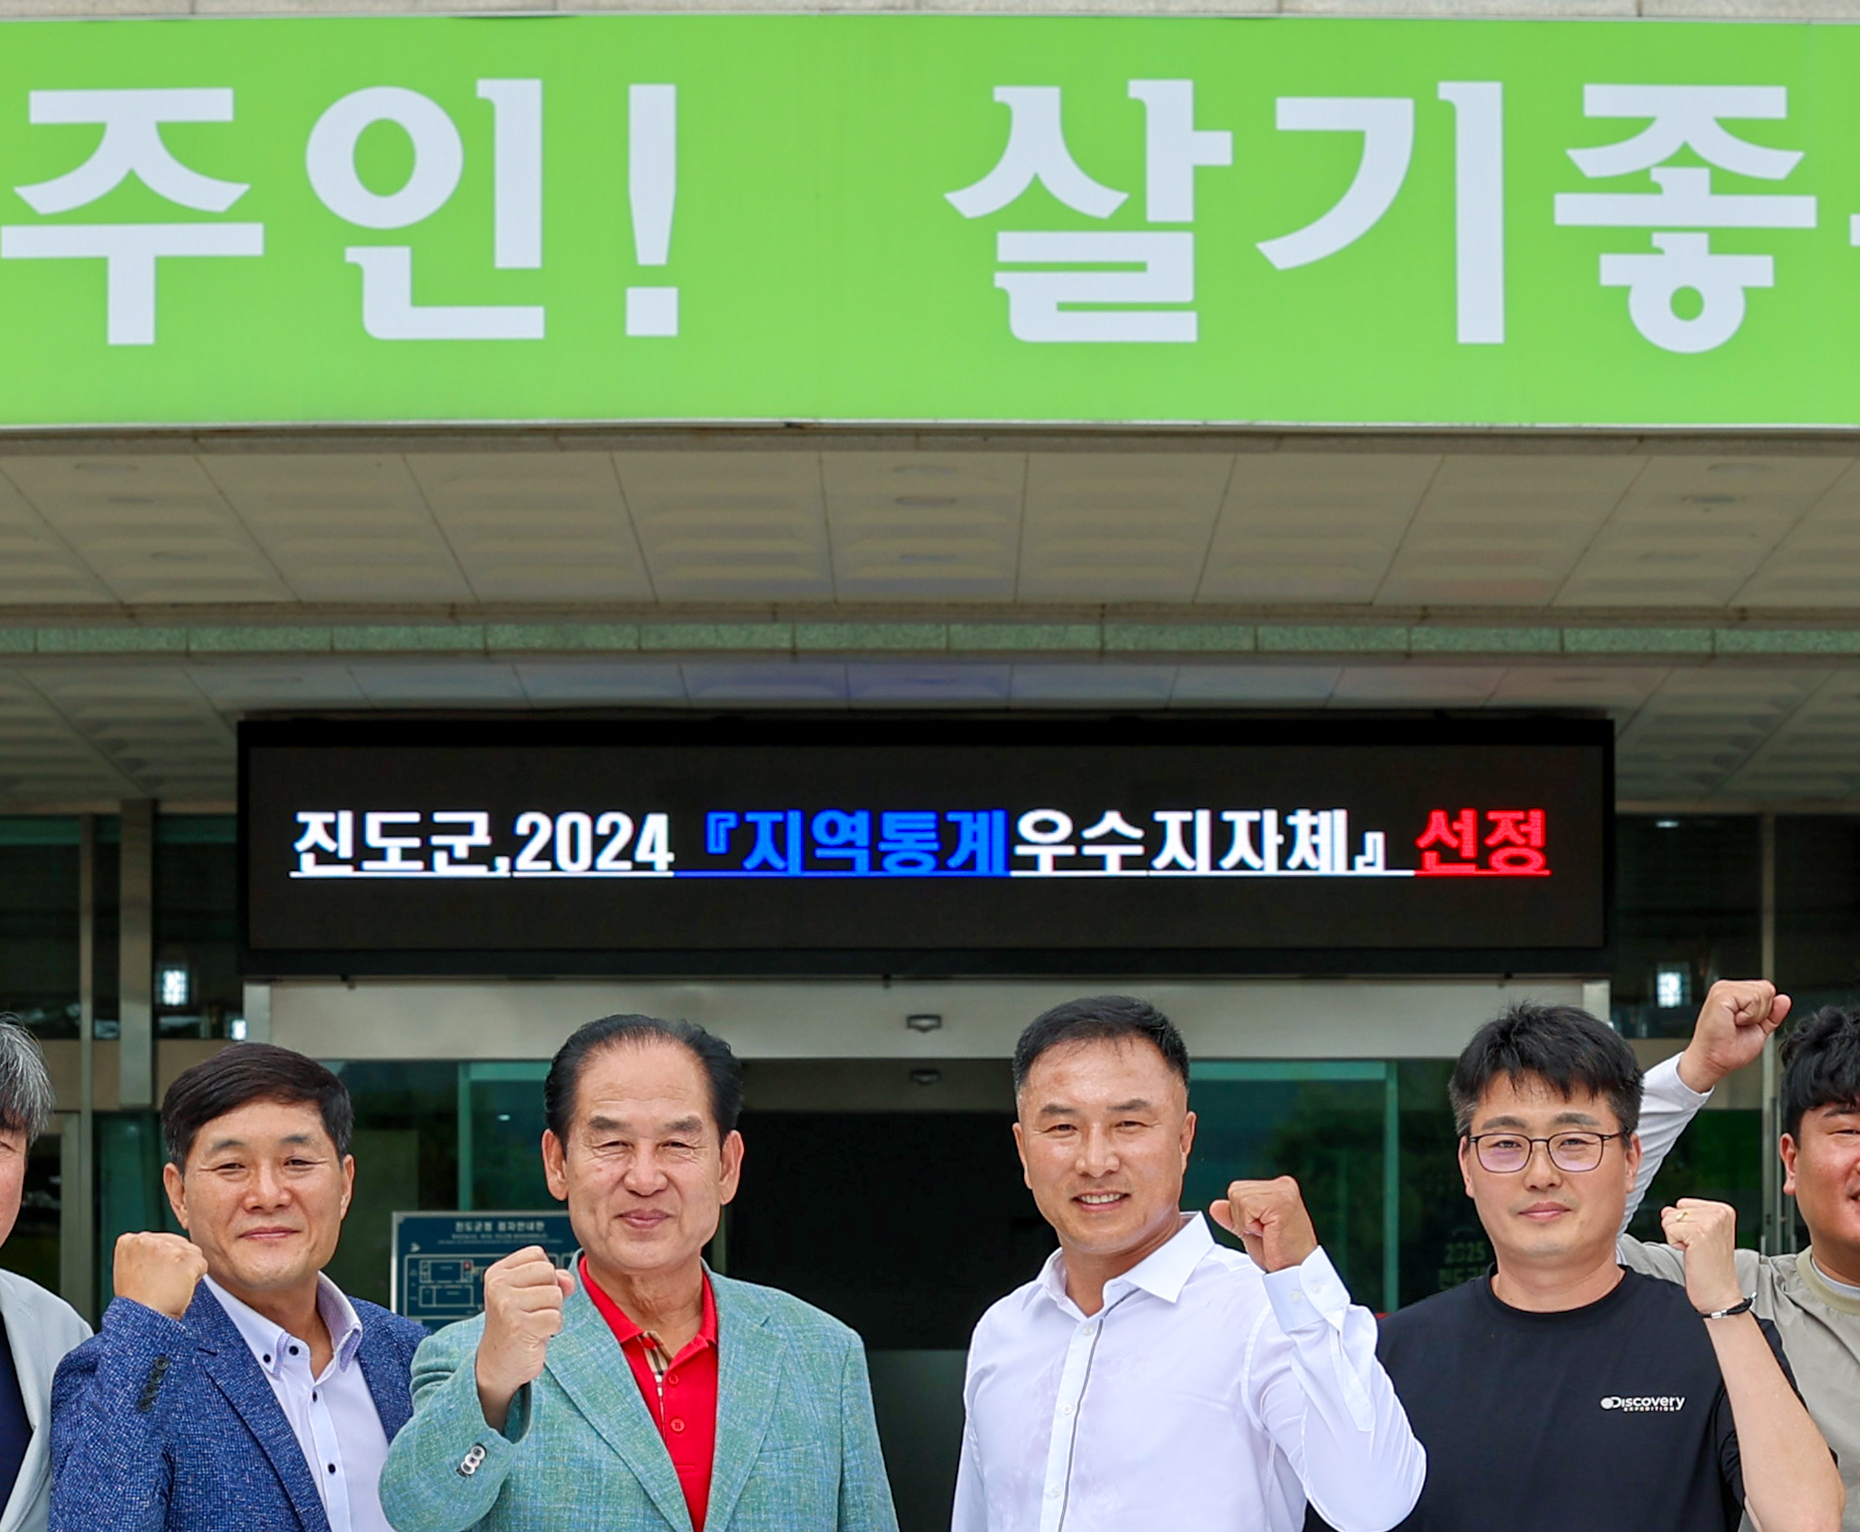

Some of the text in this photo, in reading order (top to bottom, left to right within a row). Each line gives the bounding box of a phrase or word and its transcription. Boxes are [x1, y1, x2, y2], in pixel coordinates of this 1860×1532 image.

[0, 78, 679, 345] 주인!
[292, 808, 675, 873] 진도군,2024
[1416, 808, 1547, 873] 선정
